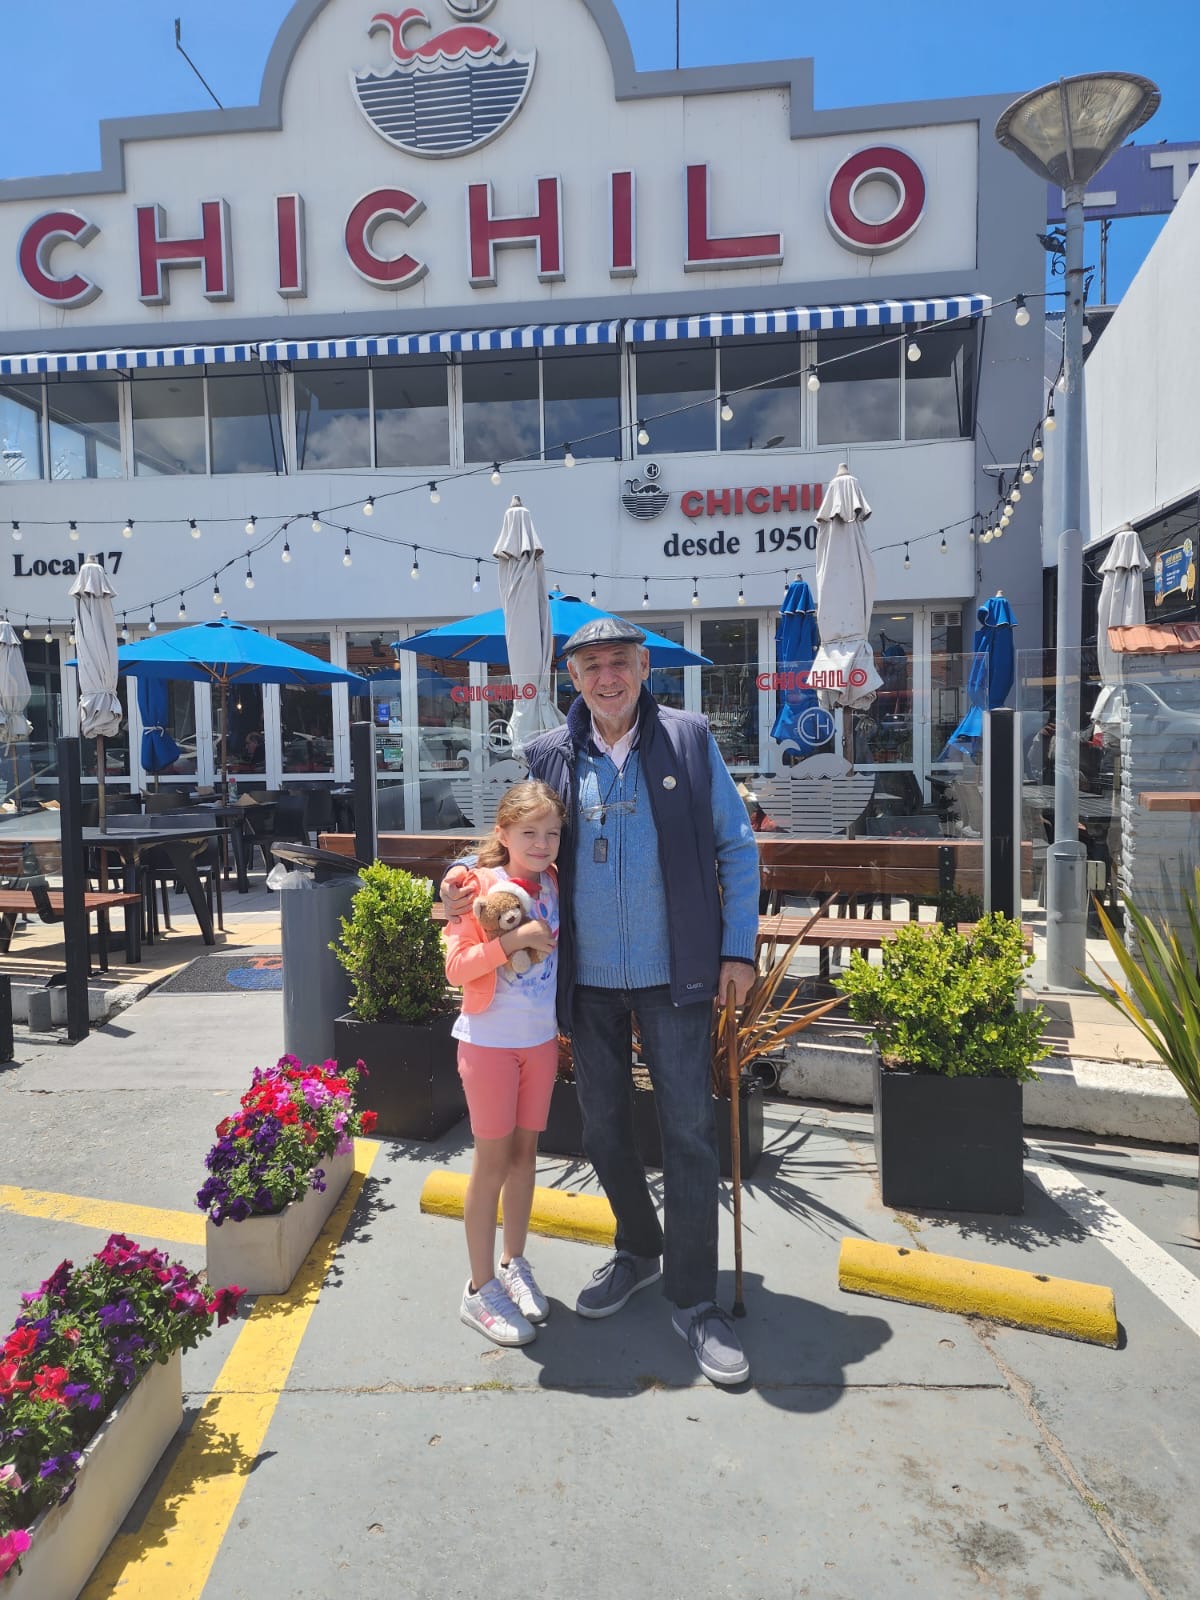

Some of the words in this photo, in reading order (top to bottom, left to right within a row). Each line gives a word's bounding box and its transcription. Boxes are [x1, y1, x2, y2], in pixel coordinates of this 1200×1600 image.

[17, 144, 927, 309] CHICHILO
[680, 483, 823, 518] CHICHI
[663, 531, 740, 557] desde
[754, 525, 818, 553] 1950
[12, 553, 85, 577] Local
[95, 551, 123, 575] 17
[451, 683, 537, 703] CHICHILO
[755, 668, 867, 691] CHICHILO
[801, 713, 829, 740] CH
